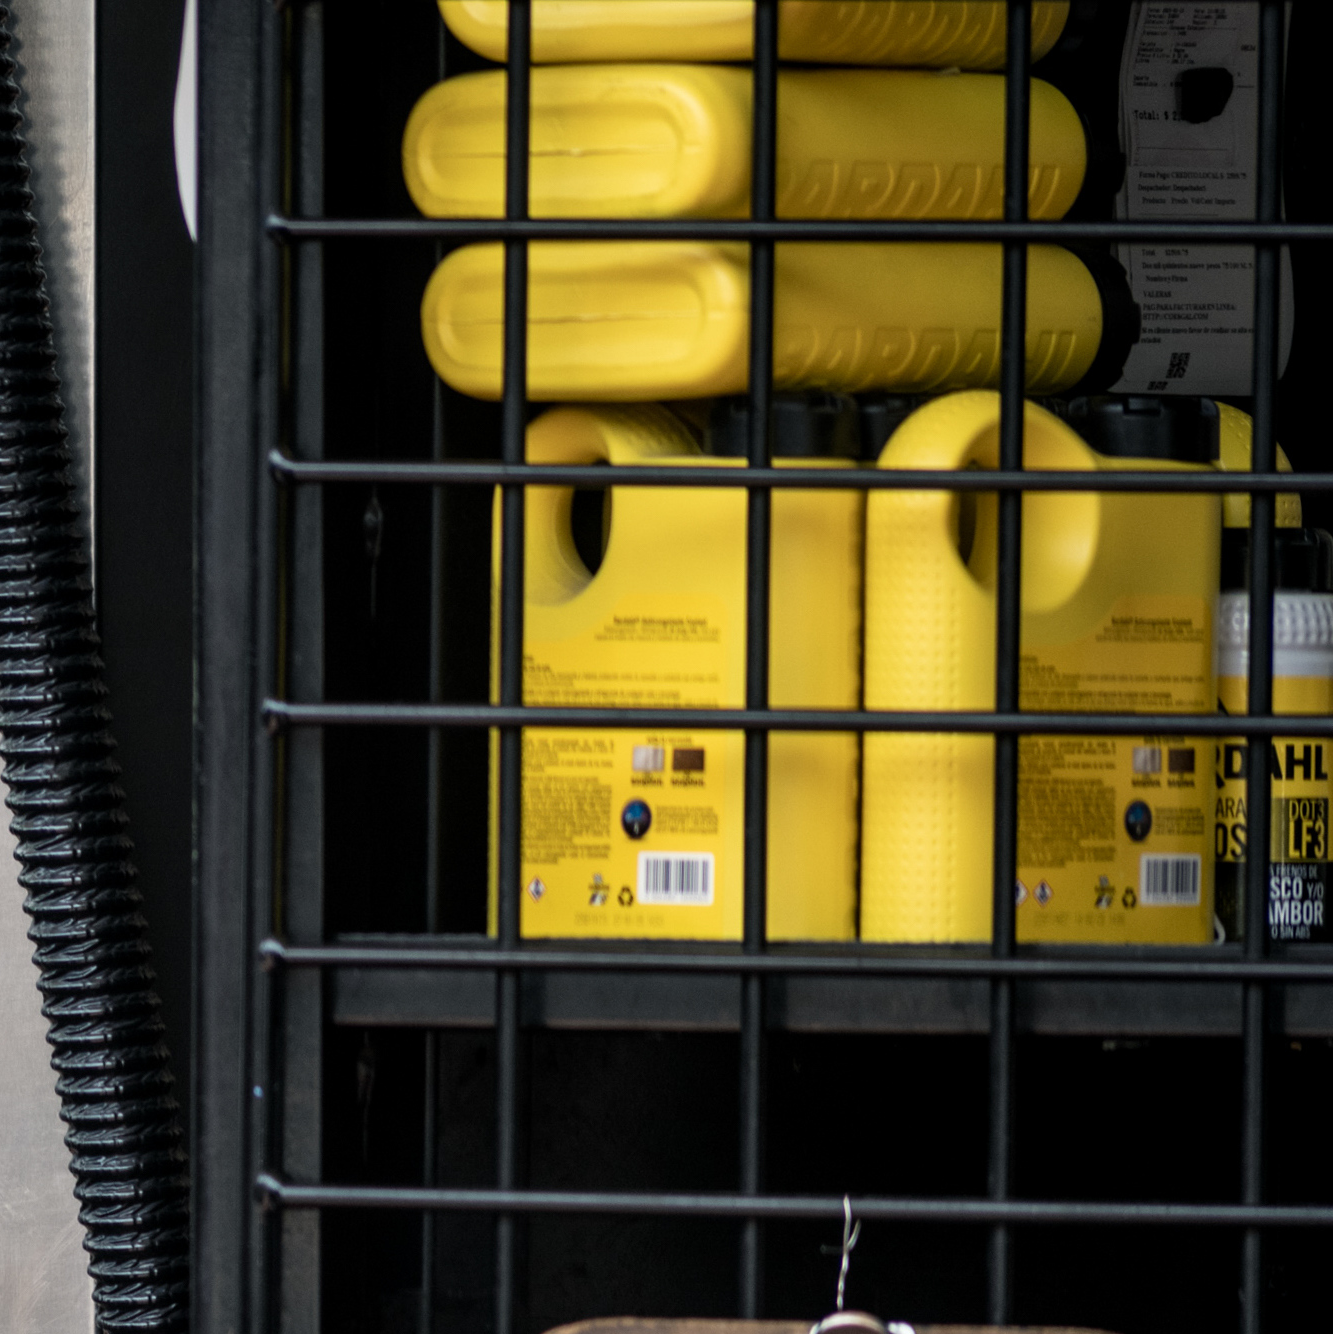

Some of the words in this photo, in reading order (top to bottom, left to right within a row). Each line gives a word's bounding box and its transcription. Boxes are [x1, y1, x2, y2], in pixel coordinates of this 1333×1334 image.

[1289, 799, 1325, 821] DOT3
[1288, 820, 1325, 859] LF3
[1276, 864, 1306, 880] FRENOS
[1309, 864, 1318, 879] DE
[1269, 876, 1303, 899] SCO
[1306, 882, 1324, 899] Y/O
